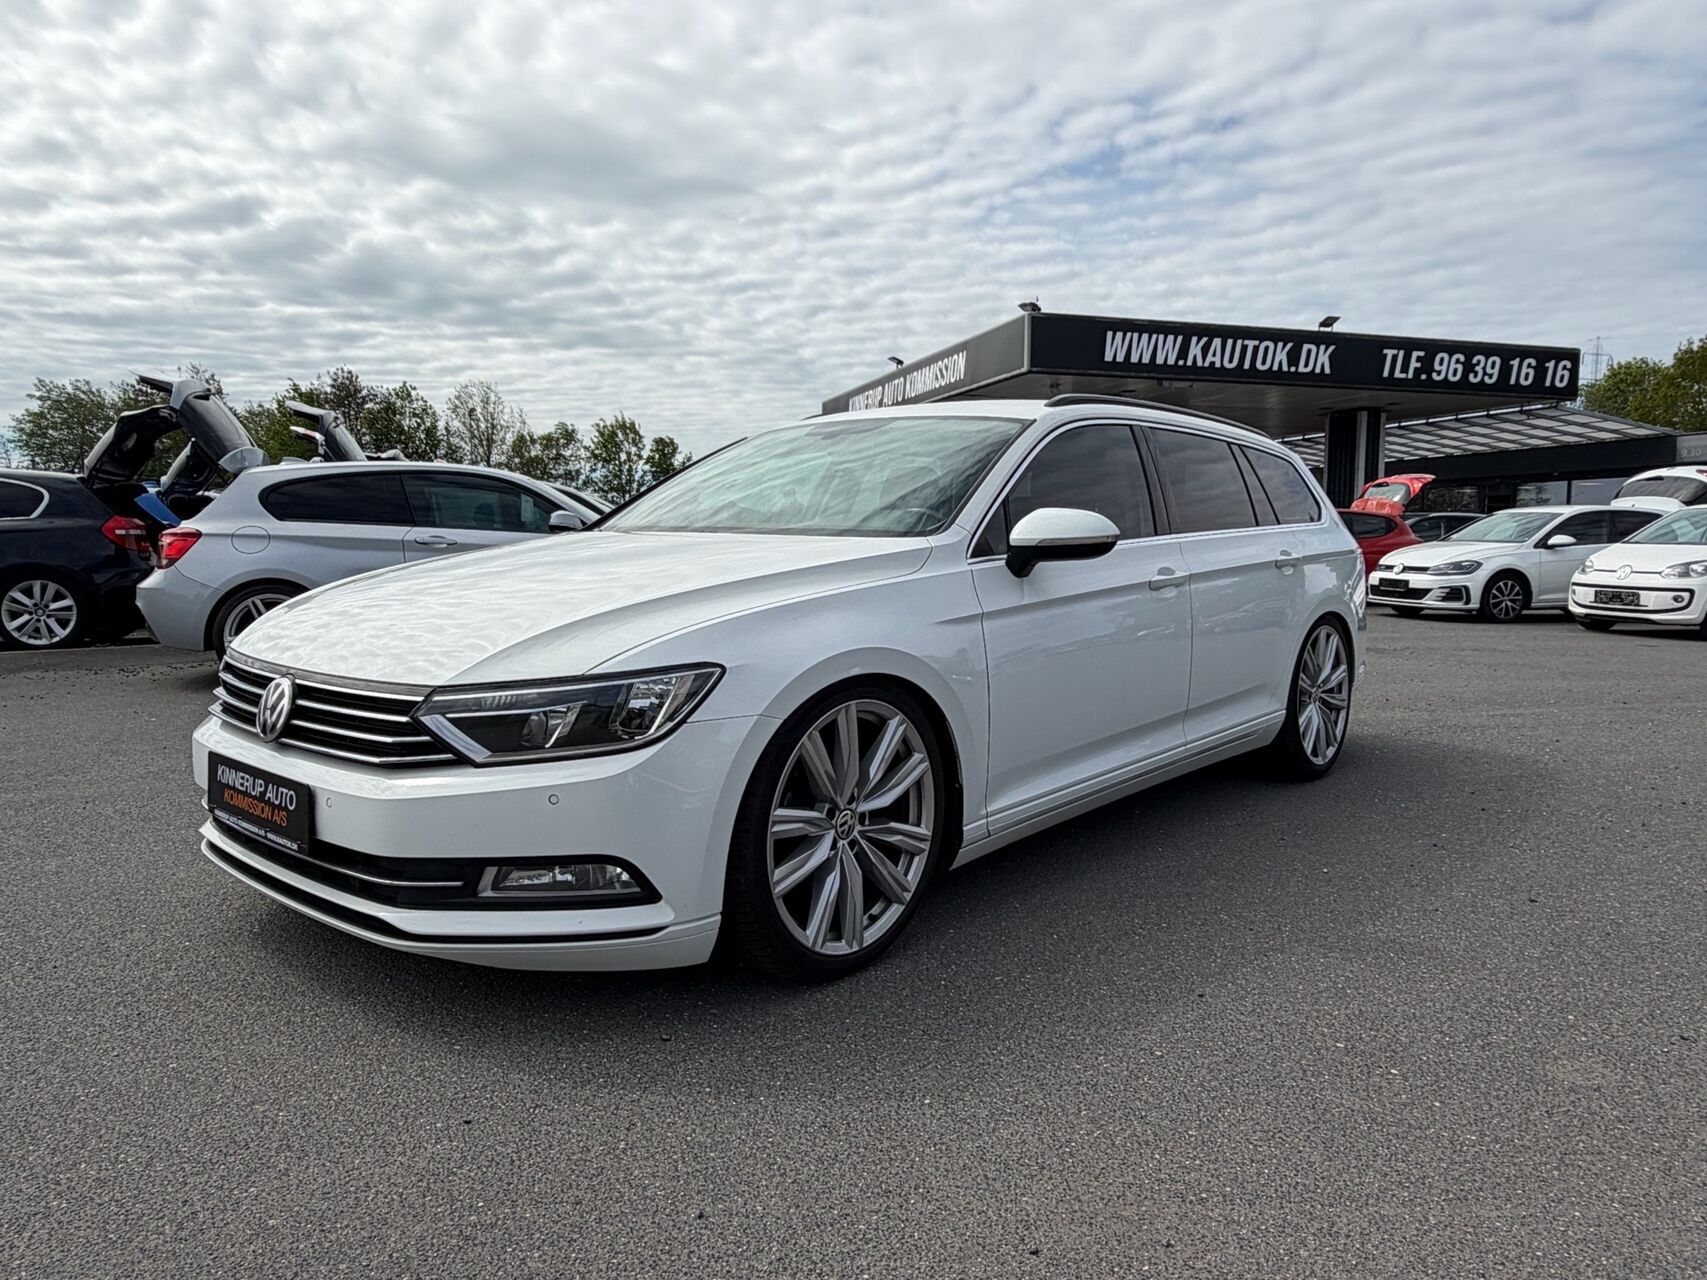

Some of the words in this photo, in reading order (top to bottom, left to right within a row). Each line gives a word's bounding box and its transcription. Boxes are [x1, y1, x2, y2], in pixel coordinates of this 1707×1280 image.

[1104, 330, 1336, 374] WWW.KAUTOK.DK
[1382, 349, 1427, 380] TLF.
[1431, 352, 1466, 382] 96
[1468, 355, 1501, 384] 39
[1509, 357, 1537, 386] 16
[1544, 359, 1572, 388] 16
[882, 377, 905, 408] AUTO
[905, 350, 967, 400] KOMMISSION
[217, 763, 265, 797] KINNERUP
[265, 783, 297, 811] AUTO
[223, 788, 273, 820] KOMMISSION
[273, 808, 288, 828] A/S
